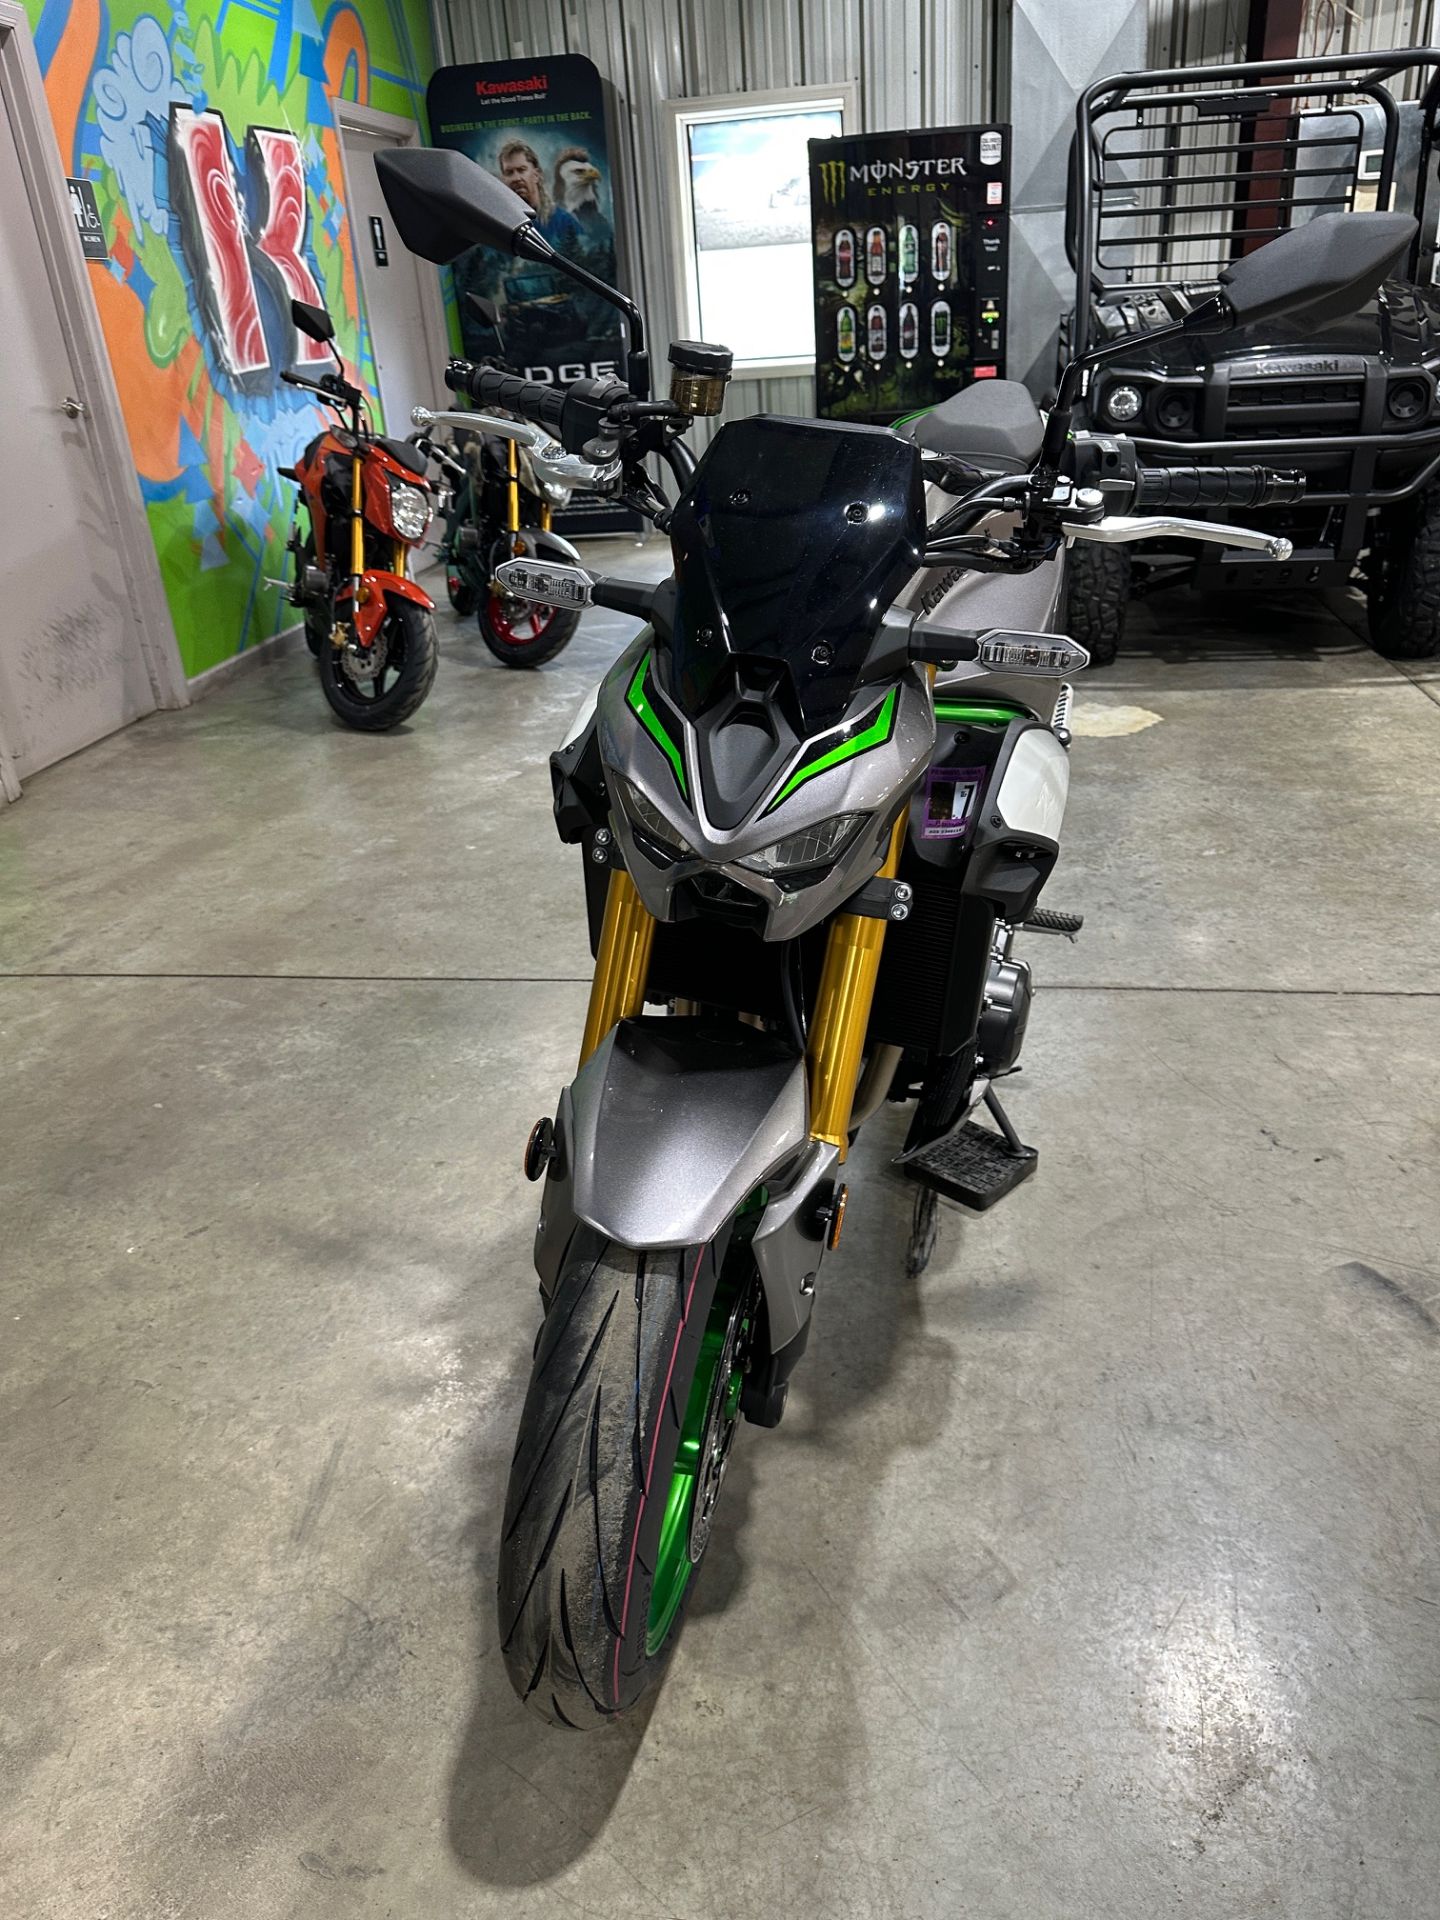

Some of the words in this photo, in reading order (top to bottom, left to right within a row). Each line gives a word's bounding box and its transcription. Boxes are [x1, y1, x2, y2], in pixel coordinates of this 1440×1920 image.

[475, 75, 548, 95] Kawasaki
[516, 94, 533, 102] Times
[850, 157, 967, 184] MONSTER
[867, 182, 950, 196] ENERGY
[1256, 360, 1339, 374] Kawasaki
